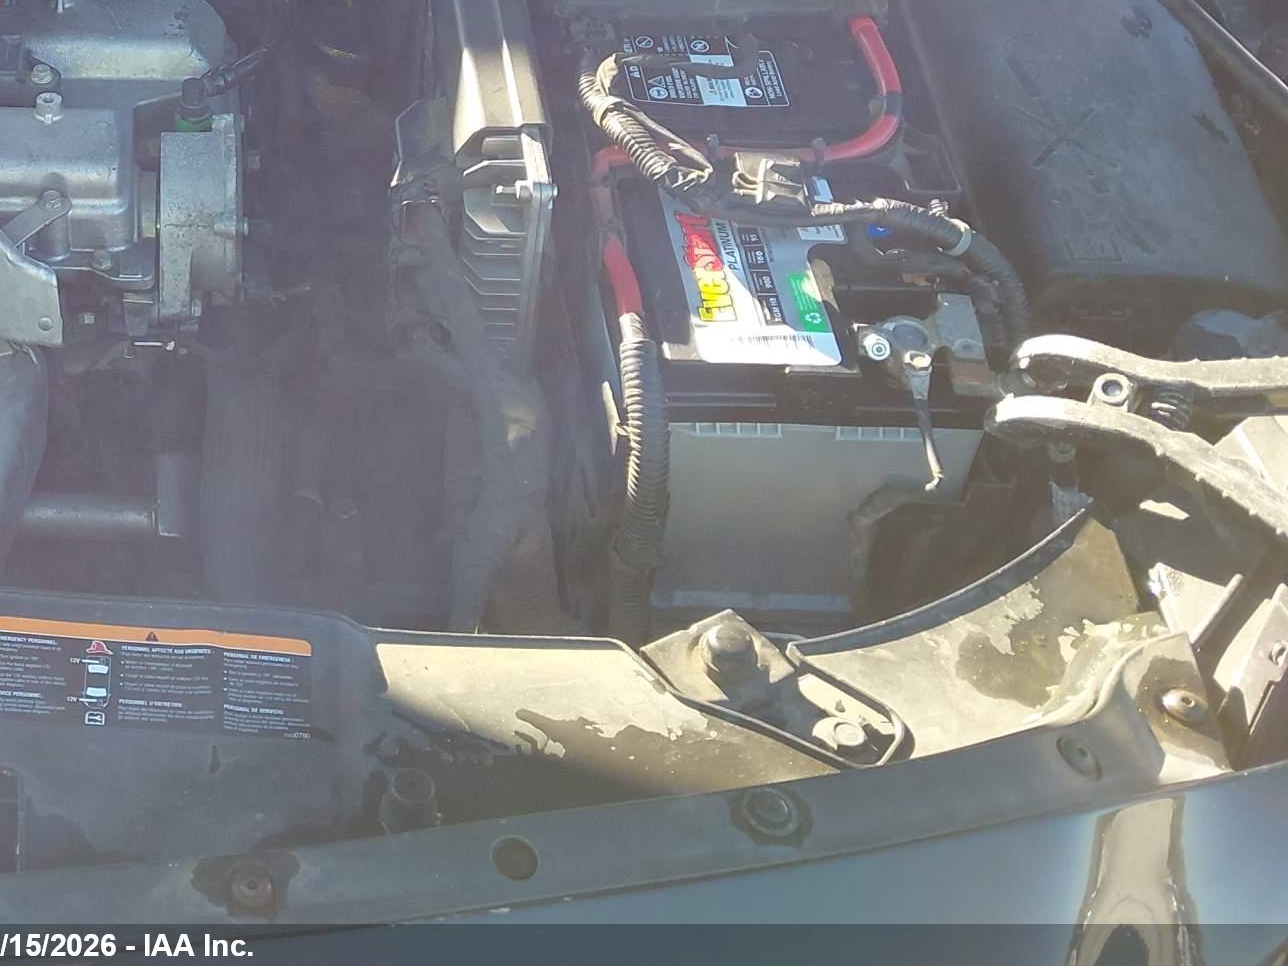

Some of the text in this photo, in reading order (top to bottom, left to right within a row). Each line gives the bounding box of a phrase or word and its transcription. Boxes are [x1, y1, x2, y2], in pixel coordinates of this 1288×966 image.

[715, 221, 741, 271] PLATINUM
[755, 250, 765, 264] 160
[762, 275, 773, 289] 900
